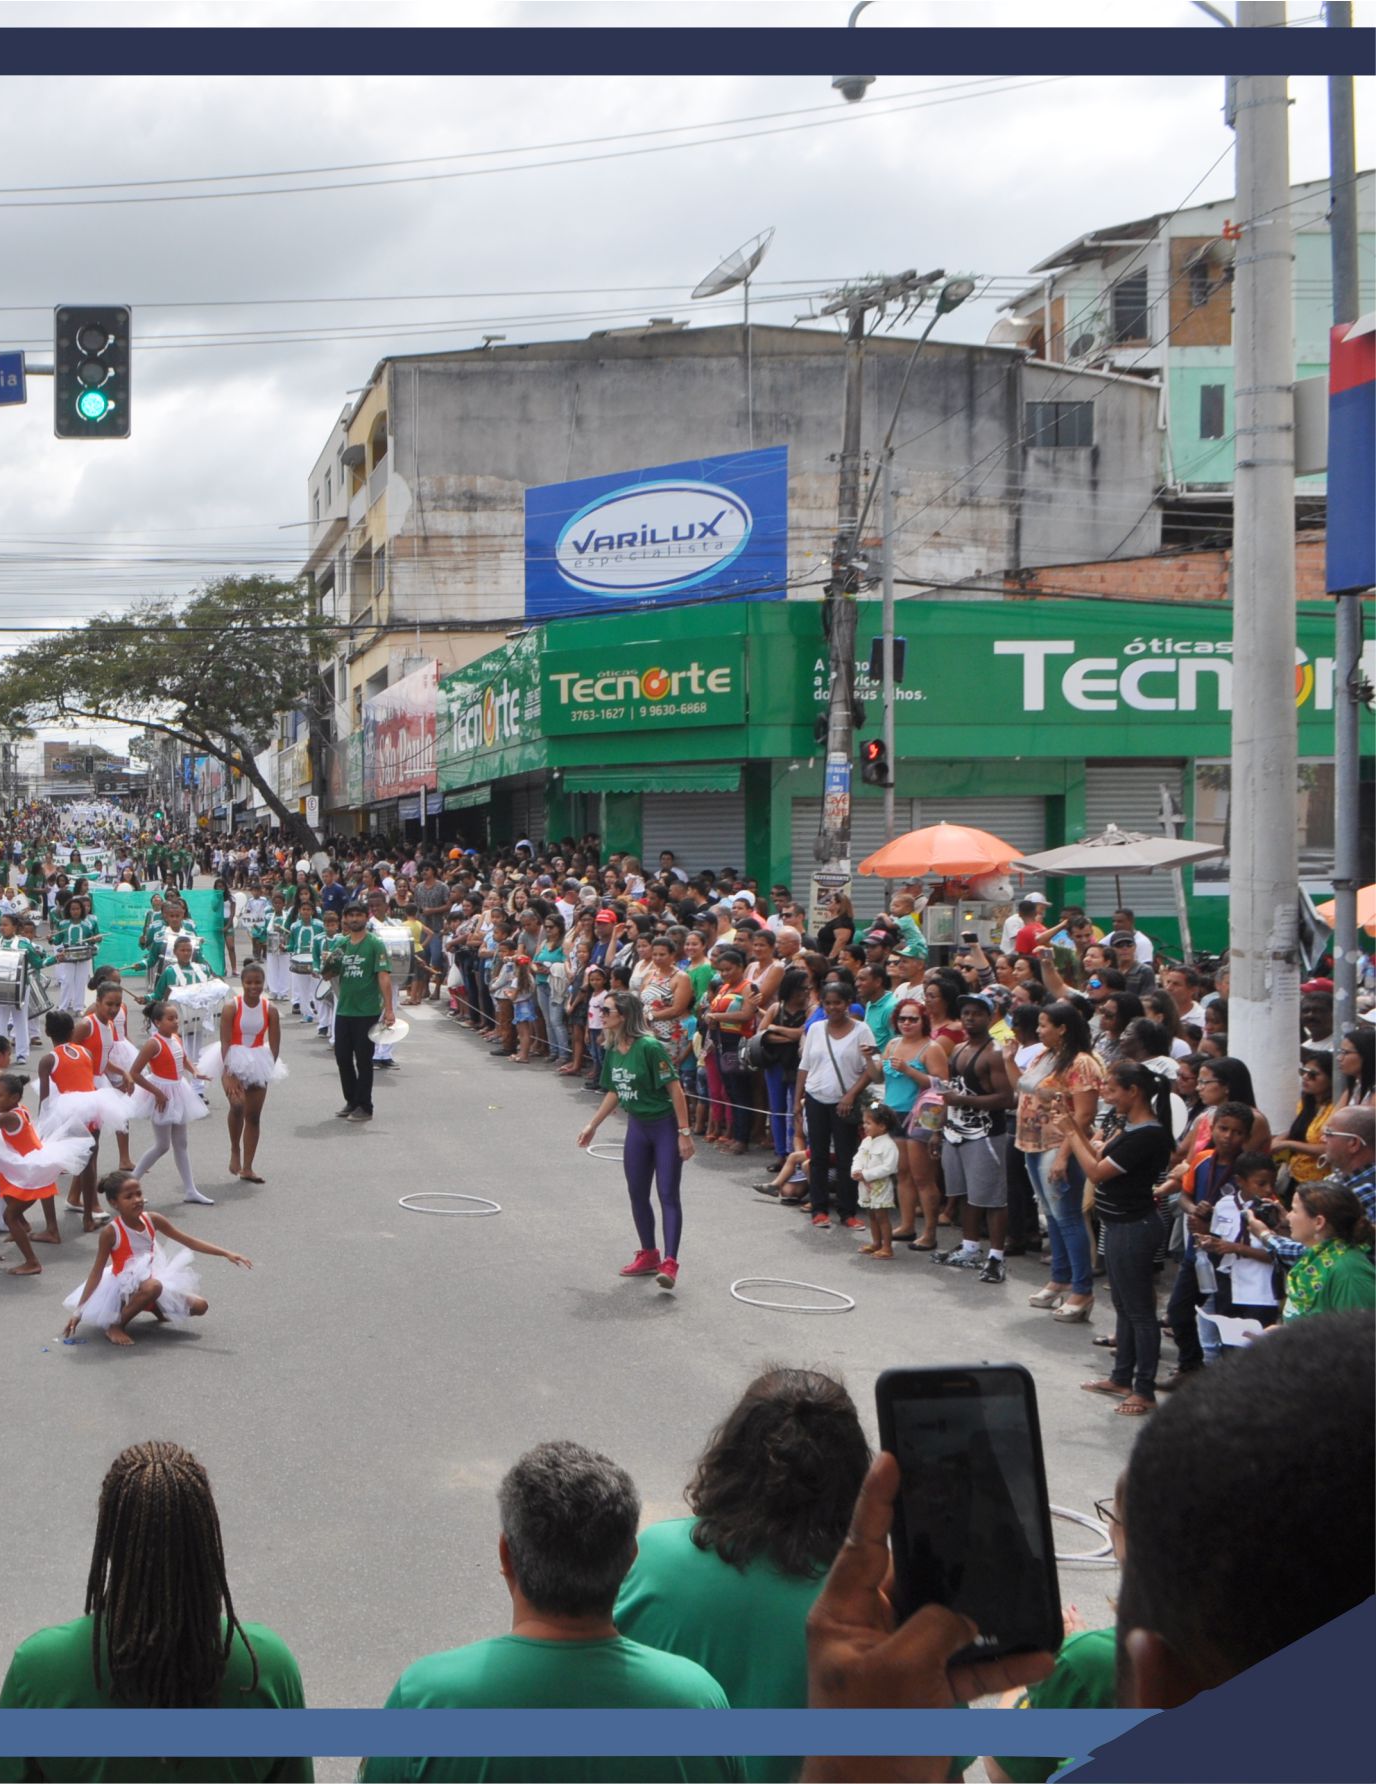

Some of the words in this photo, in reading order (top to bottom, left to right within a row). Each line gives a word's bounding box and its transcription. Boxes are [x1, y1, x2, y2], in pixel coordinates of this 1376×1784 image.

[575, 541, 724, 569] especialista
[814, 658, 825, 671] A
[597, 668, 638, 677] óticas
[814, 676, 822, 686] a
[570, 708, 625, 721] 3763-1627
[639, 707, 647, 718] 9
[649, 703, 707, 717] 9630-6868
